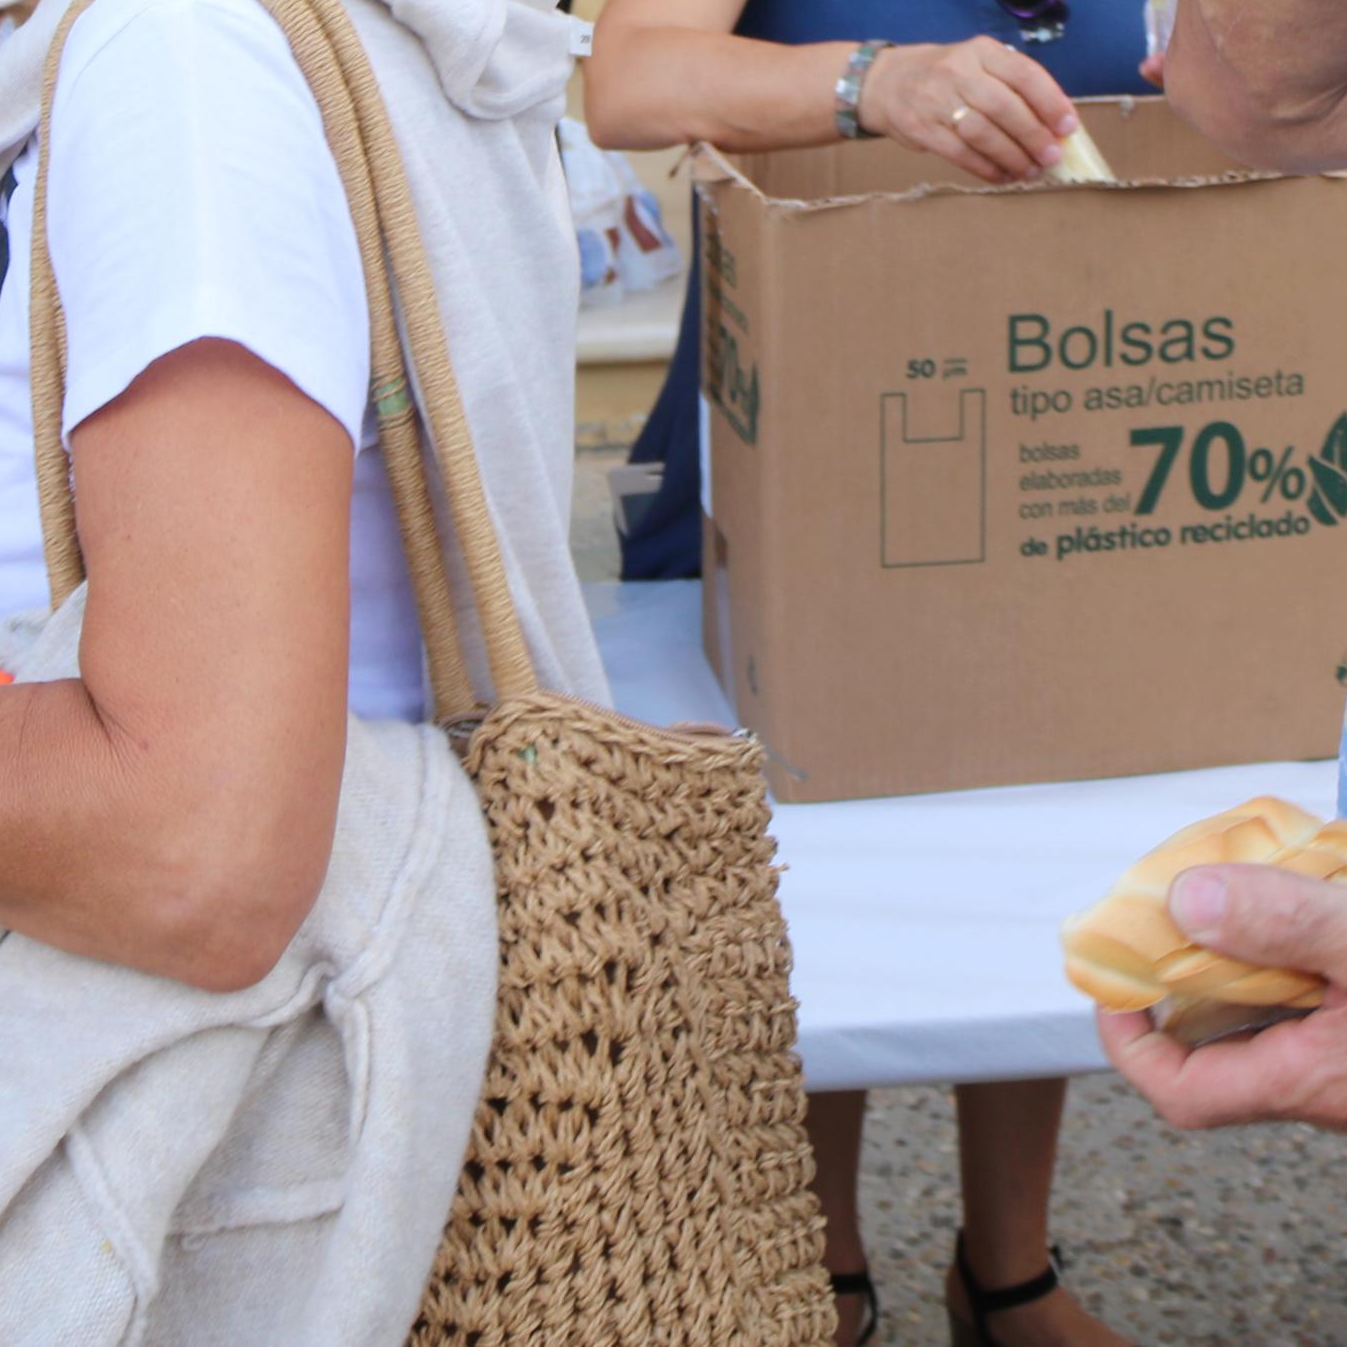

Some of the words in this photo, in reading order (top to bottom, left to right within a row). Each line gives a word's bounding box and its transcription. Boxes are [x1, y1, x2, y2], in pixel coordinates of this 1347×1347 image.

[1007, 308, 1236, 373] Bolsas
[906, 359, 936, 379] 50
[1010, 383, 1073, 421] tipo
[1083, 368, 1305, 412] asa/camiseta
[1018, 441, 1080, 463] bolsas
[1129, 421, 1306, 516] 70%
[1018, 468, 1122, 492] elaboradas
[1018, 500, 1052, 520] con
[1057, 494, 1097, 516] más
[1103, 492, 1132, 511] del
[1019, 538, 1049, 558] de
[1056, 524, 1172, 561] plástico
[1180, 510, 1311, 546] reciclado
